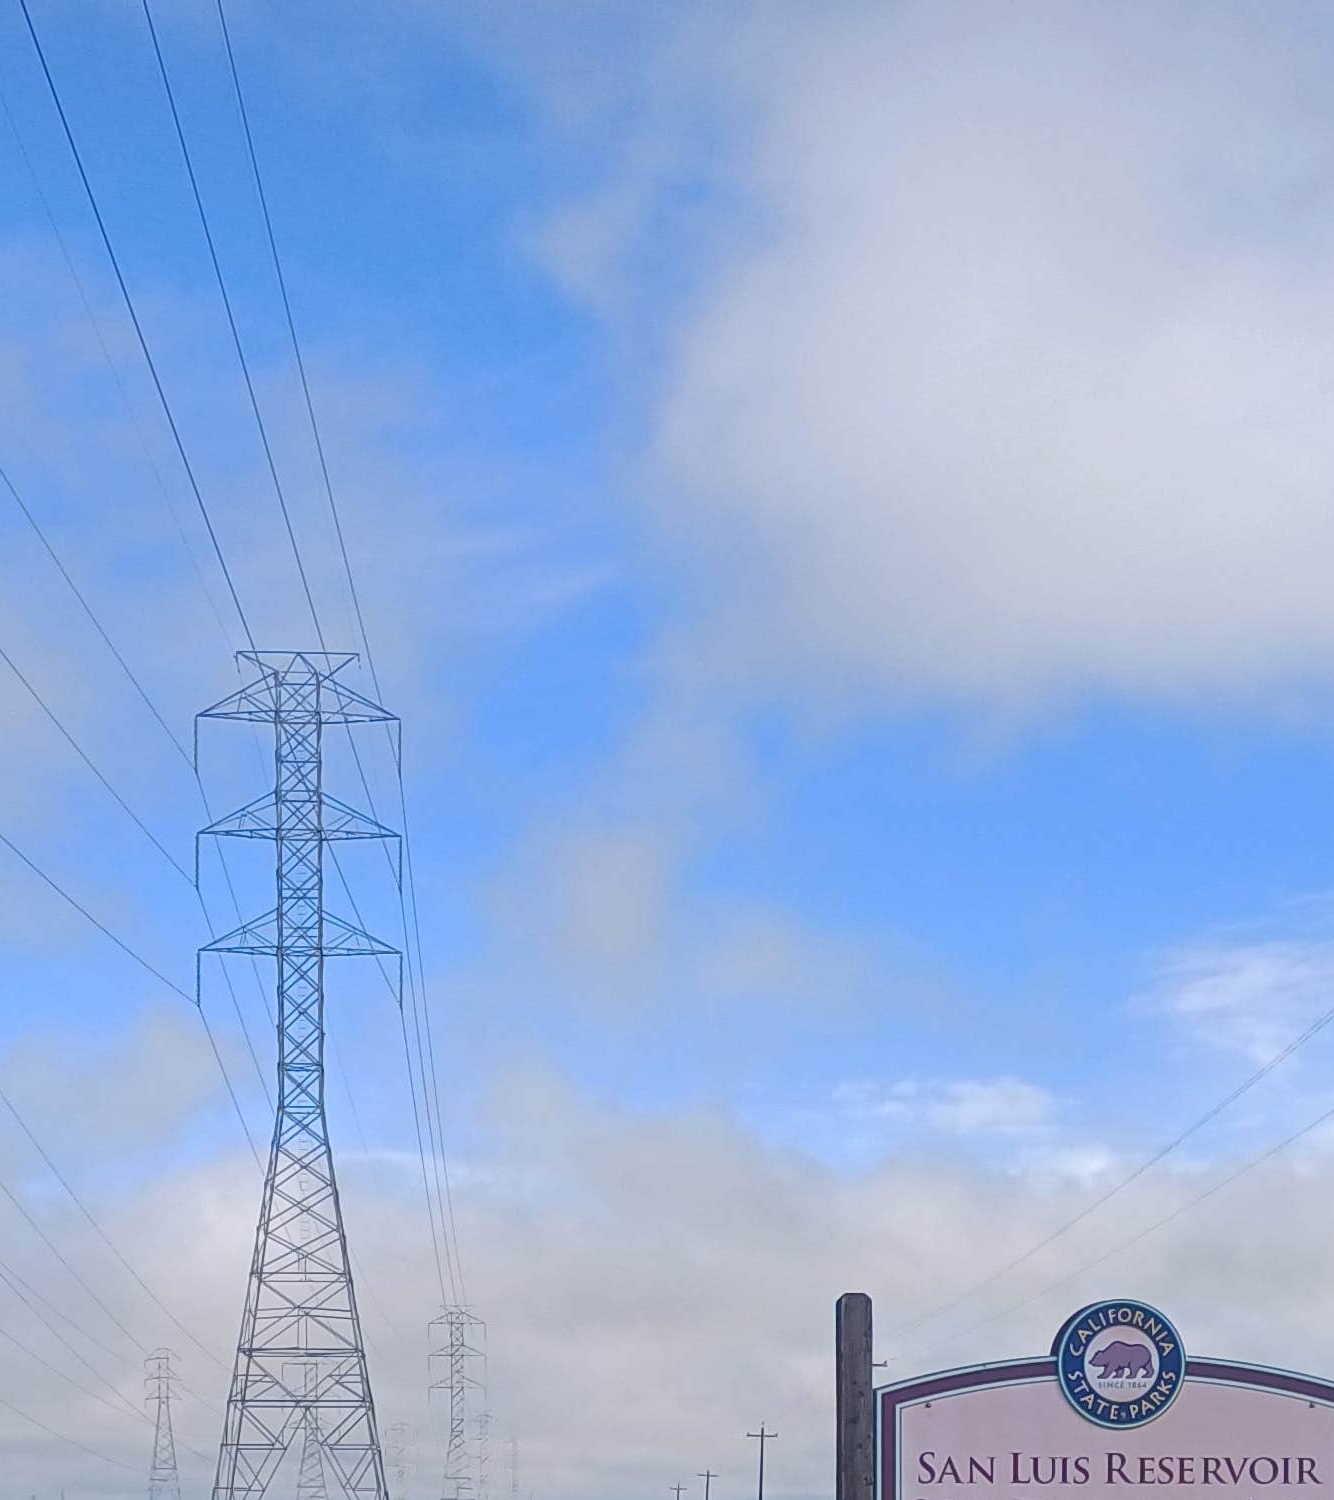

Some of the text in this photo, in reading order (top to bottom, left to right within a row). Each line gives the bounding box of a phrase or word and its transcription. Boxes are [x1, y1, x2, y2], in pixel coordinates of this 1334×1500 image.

[1069, 1307, 1175, 1357] CALIFORNIA
[1067, 1370, 1176, 1420] STATE PARKS
[1098, 1381, 1147, 1389] SINCE 1864
[917, 1451, 1323, 1485] SAN LUIS RESERVOIR
